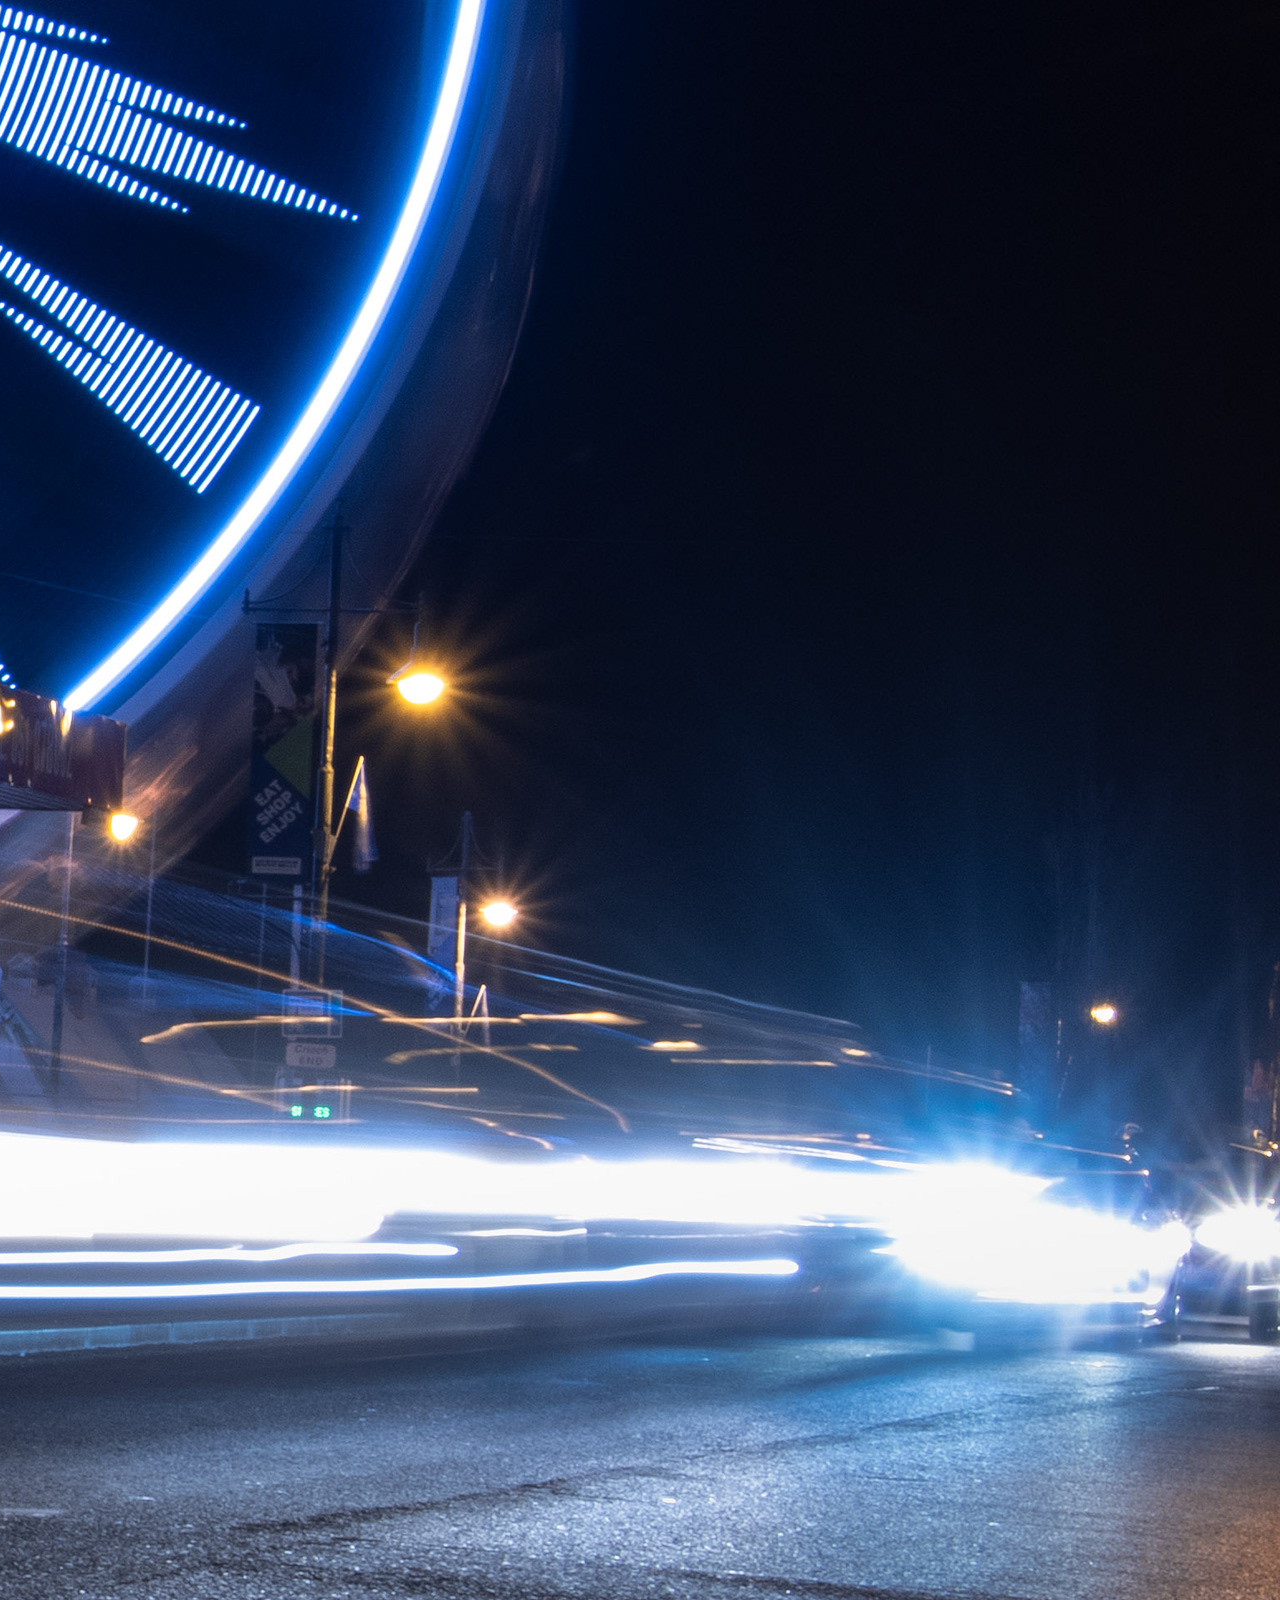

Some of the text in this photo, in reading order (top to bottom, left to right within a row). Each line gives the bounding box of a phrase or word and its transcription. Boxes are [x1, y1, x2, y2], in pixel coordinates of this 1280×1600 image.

[254, 778, 283, 807] EAT
[255, 790, 292, 826] SHOP
[259, 801, 304, 844] ENJOY
